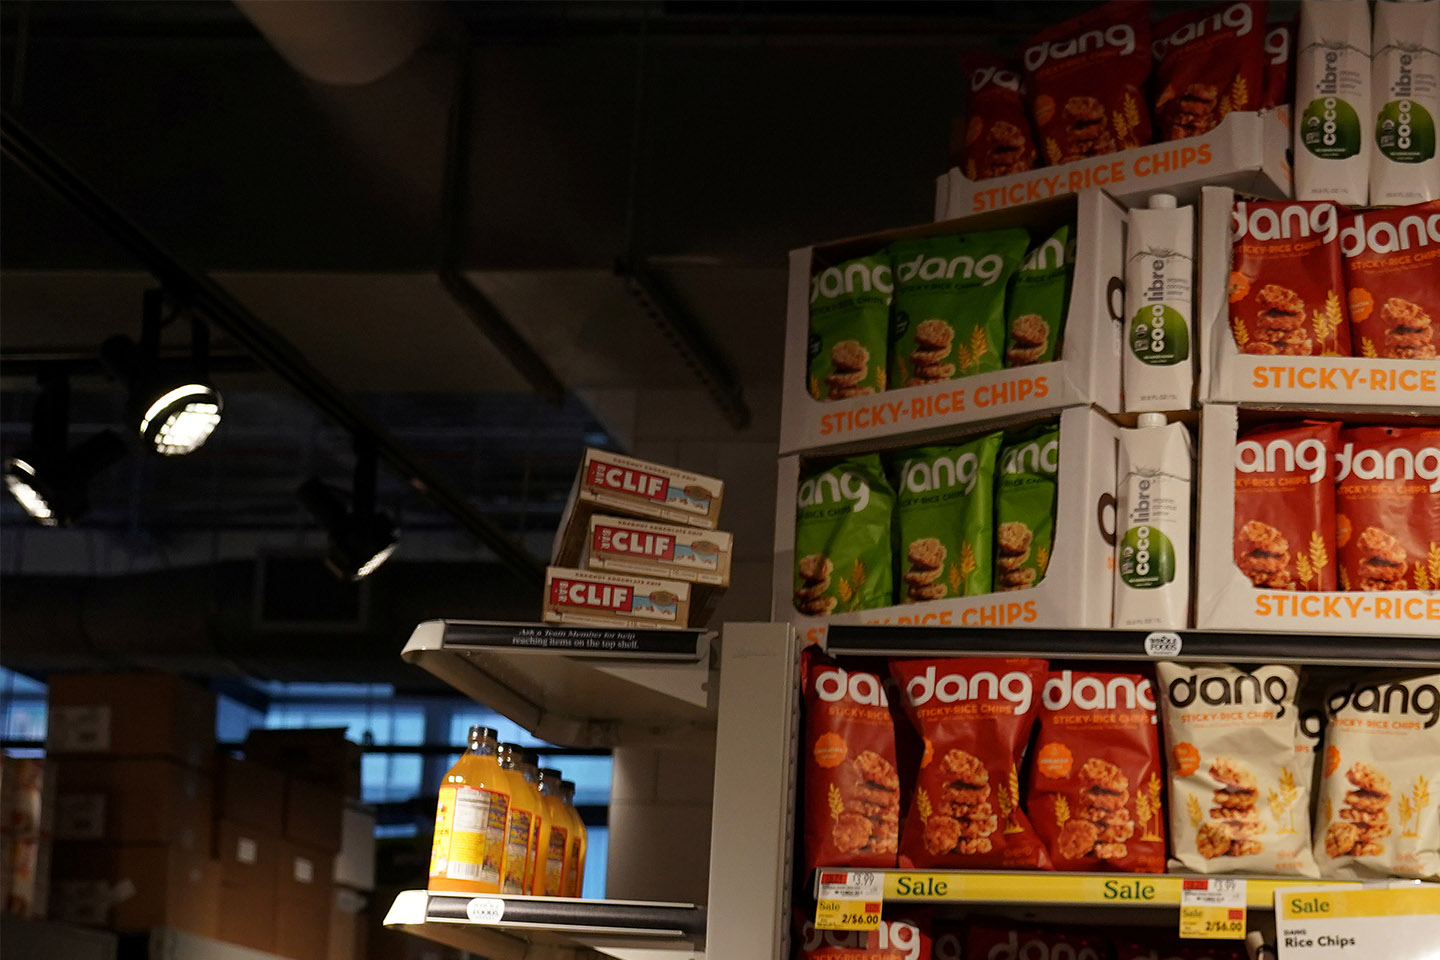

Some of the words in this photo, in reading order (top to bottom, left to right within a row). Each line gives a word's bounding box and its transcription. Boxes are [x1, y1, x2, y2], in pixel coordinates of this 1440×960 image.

[1023, 23, 1136, 71] dang
[1315, 51, 1339, 96] libre
[1394, 53, 1412, 97] libre
[1323, 98, 1337, 146] coco
[1397, 100, 1411, 149] coco
[973, 159, 1126, 212] STICKY-RICE
[1133, 144, 1212, 177] CHIPS
[899, 253, 1004, 287] dang
[1147, 260, 1165, 302] libre
[1150, 304, 1165, 354] coco
[1252, 366, 1436, 393] STICKY-RICE
[820, 390, 965, 435] STICKY-RICE
[973, 376, 1049, 410] CHIPS
[1235, 438, 1328, 484] ang
[605, 468, 664, 497] CLIF
[1133, 477, 1150, 524] libre
[611, 530, 670, 556] CLIF
[1136, 526, 1150, 576] coco
[568, 583, 628, 613] CLIF
[512, 636, 548, 647] reaching
[549, 637, 572, 647] items
[574, 639, 585, 647] on
[586, 638, 600, 648] the
[602, 640, 615, 650] top
[544, 629, 566, 638] Team
[568, 630, 602, 639] Member
[617, 632, 636, 641] help
[907, 665, 1033, 716] dang
[1168, 675, 1288, 718] dang
[1329, 682, 1440, 729] dang
[896, 877, 949, 898] Sale
[1105, 880, 1156, 900] Sale
[1291, 897, 1330, 914] Sale
[842, 914, 879, 925] 2/$6.00
[1206, 920, 1243, 932] 2/$6.00
[1285, 937, 1313, 948] Rice
[1317, 935, 1356, 949] Chips
